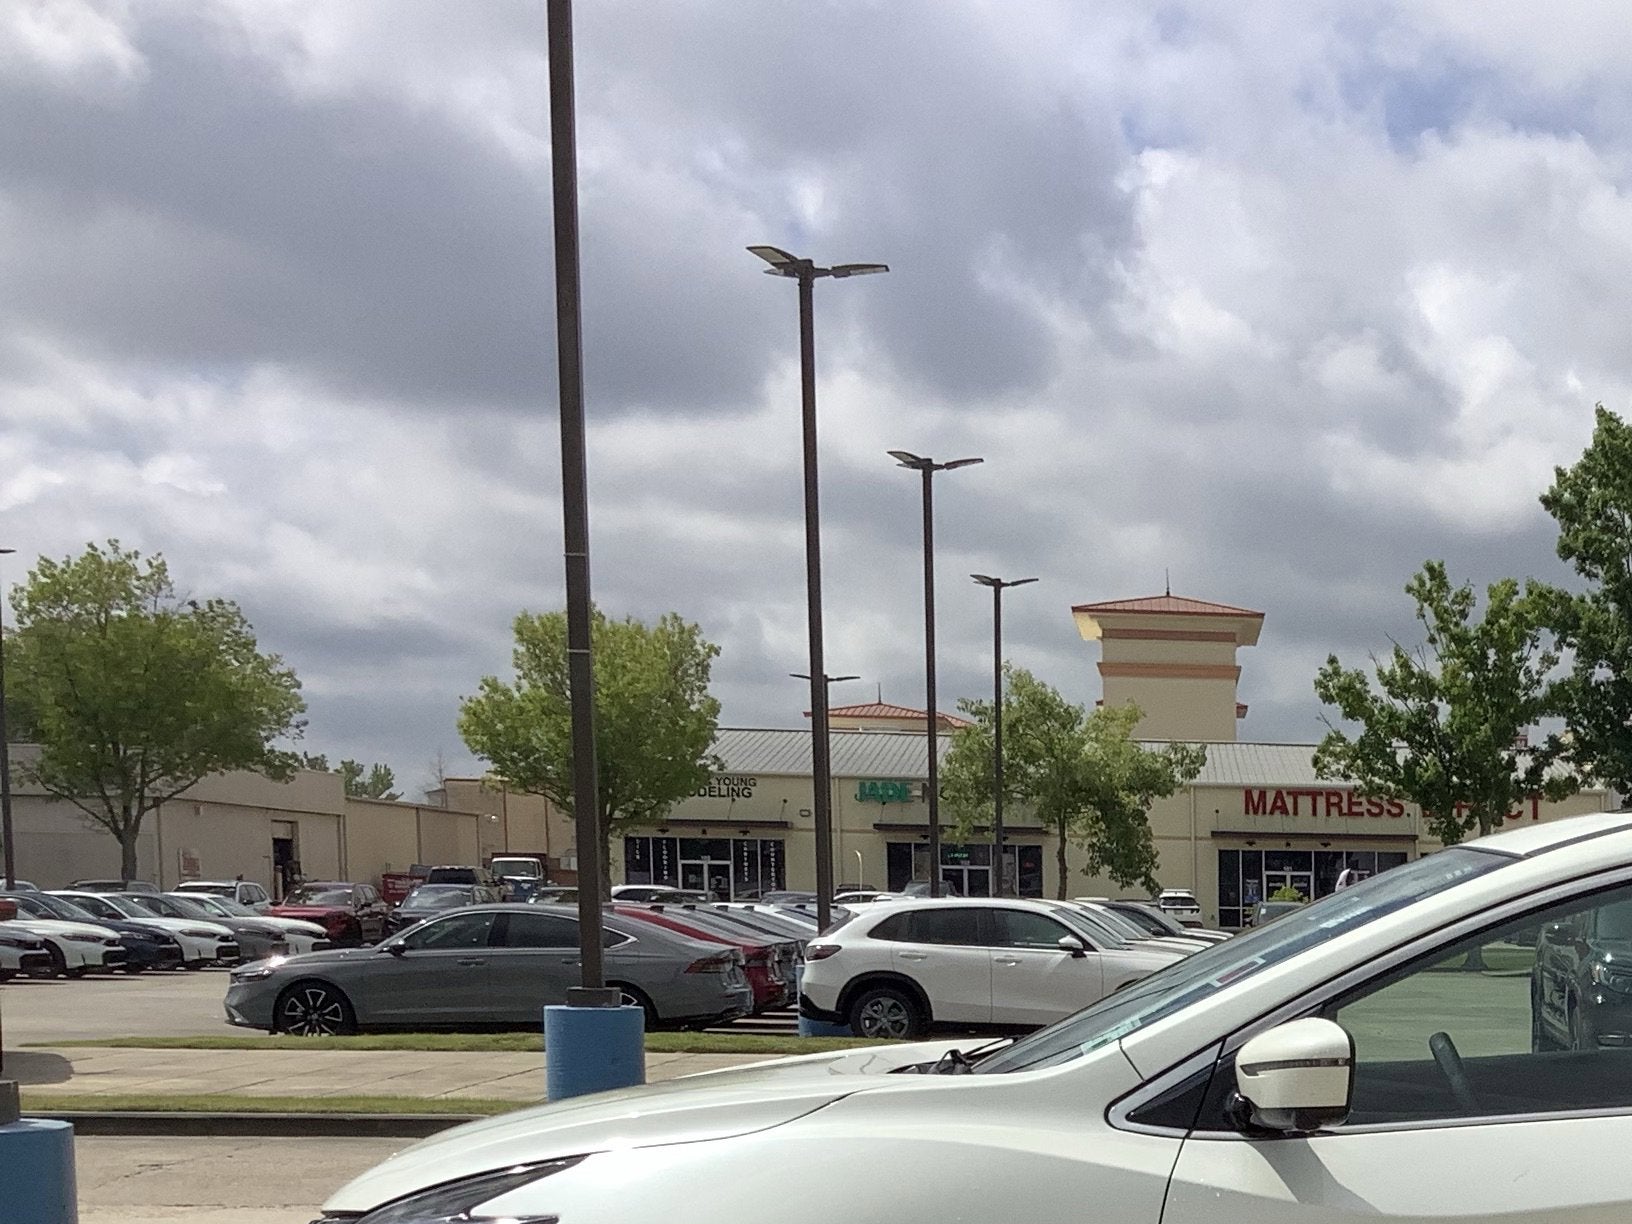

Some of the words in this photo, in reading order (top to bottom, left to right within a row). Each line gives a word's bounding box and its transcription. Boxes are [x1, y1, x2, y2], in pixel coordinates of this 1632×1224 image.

[716, 776, 757, 787] YOUNG
[855, 780, 914, 803] JADE
[1243, 787, 1405, 818] MATTRESS
